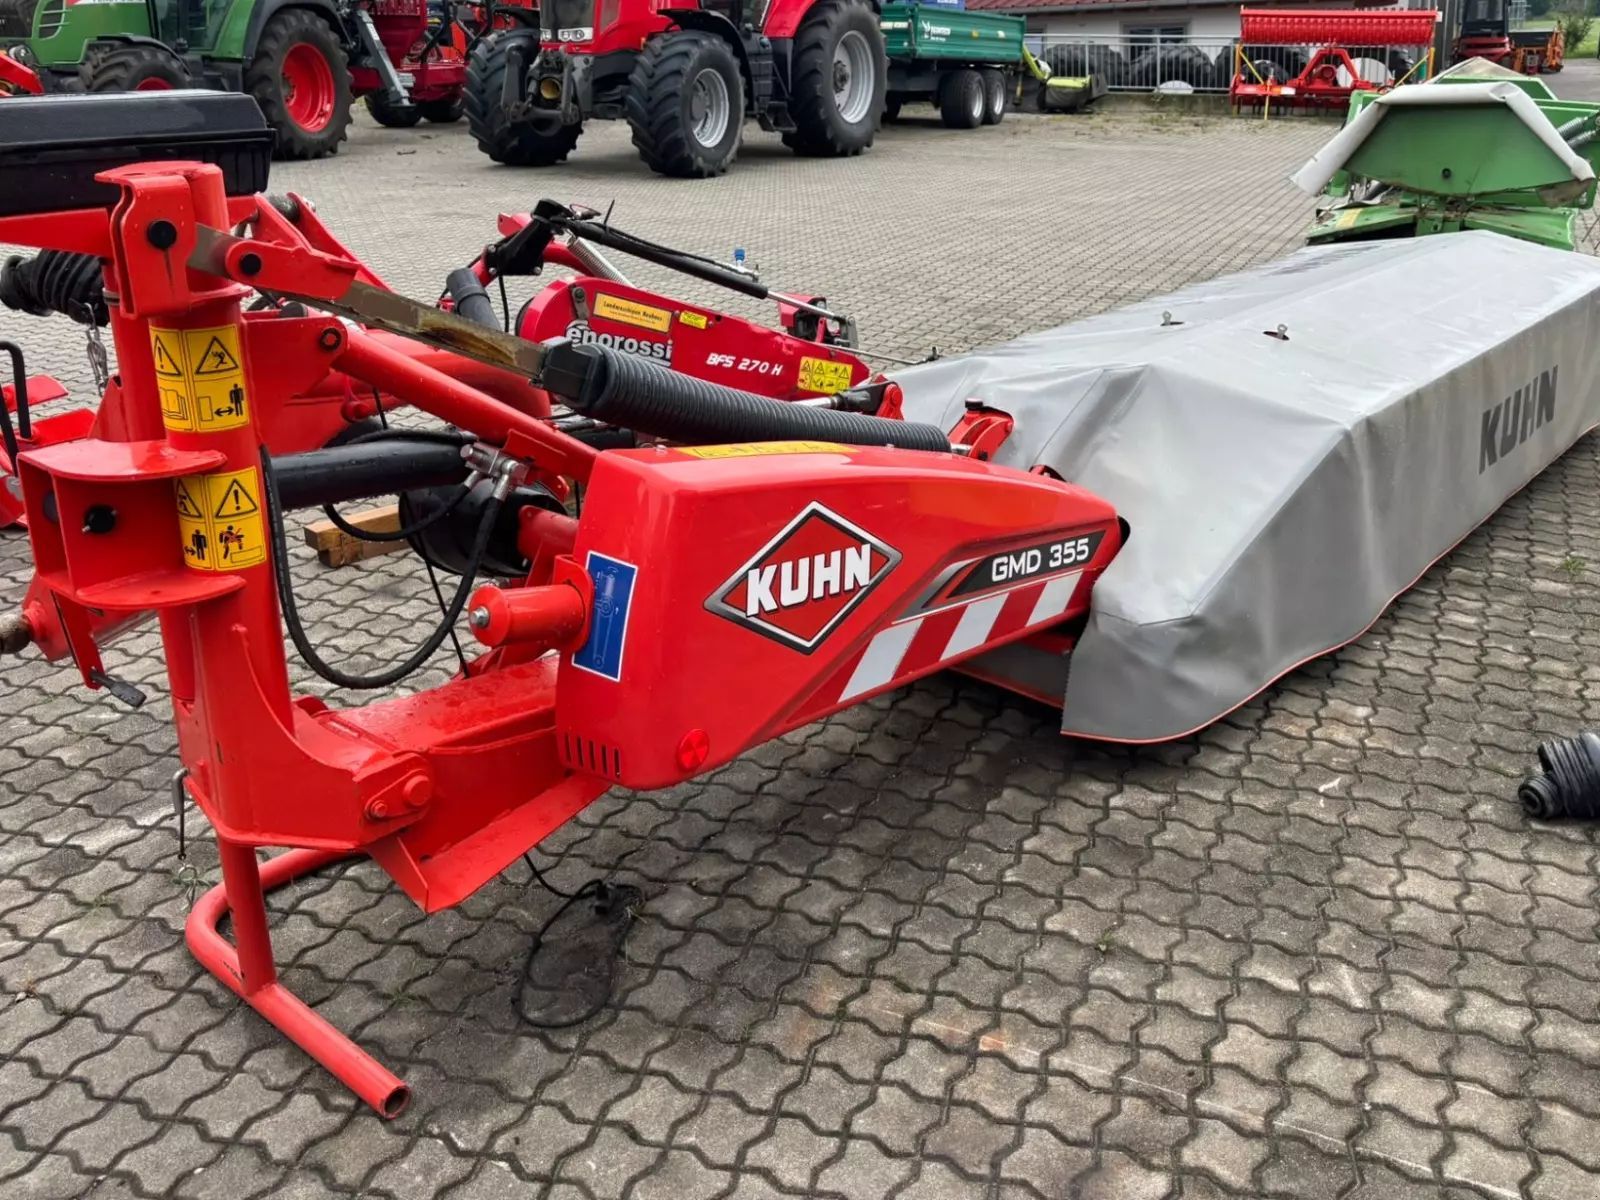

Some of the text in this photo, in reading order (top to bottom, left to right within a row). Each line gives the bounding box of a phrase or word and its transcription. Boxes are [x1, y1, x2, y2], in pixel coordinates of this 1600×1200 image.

[565, 326, 673, 359] enorossi
[706, 352, 783, 376] BFS 270 H
[1479, 365, 1558, 474] KUHN
[746, 543, 871, 617] KUHN
[991, 537, 1089, 582] GMD 355
